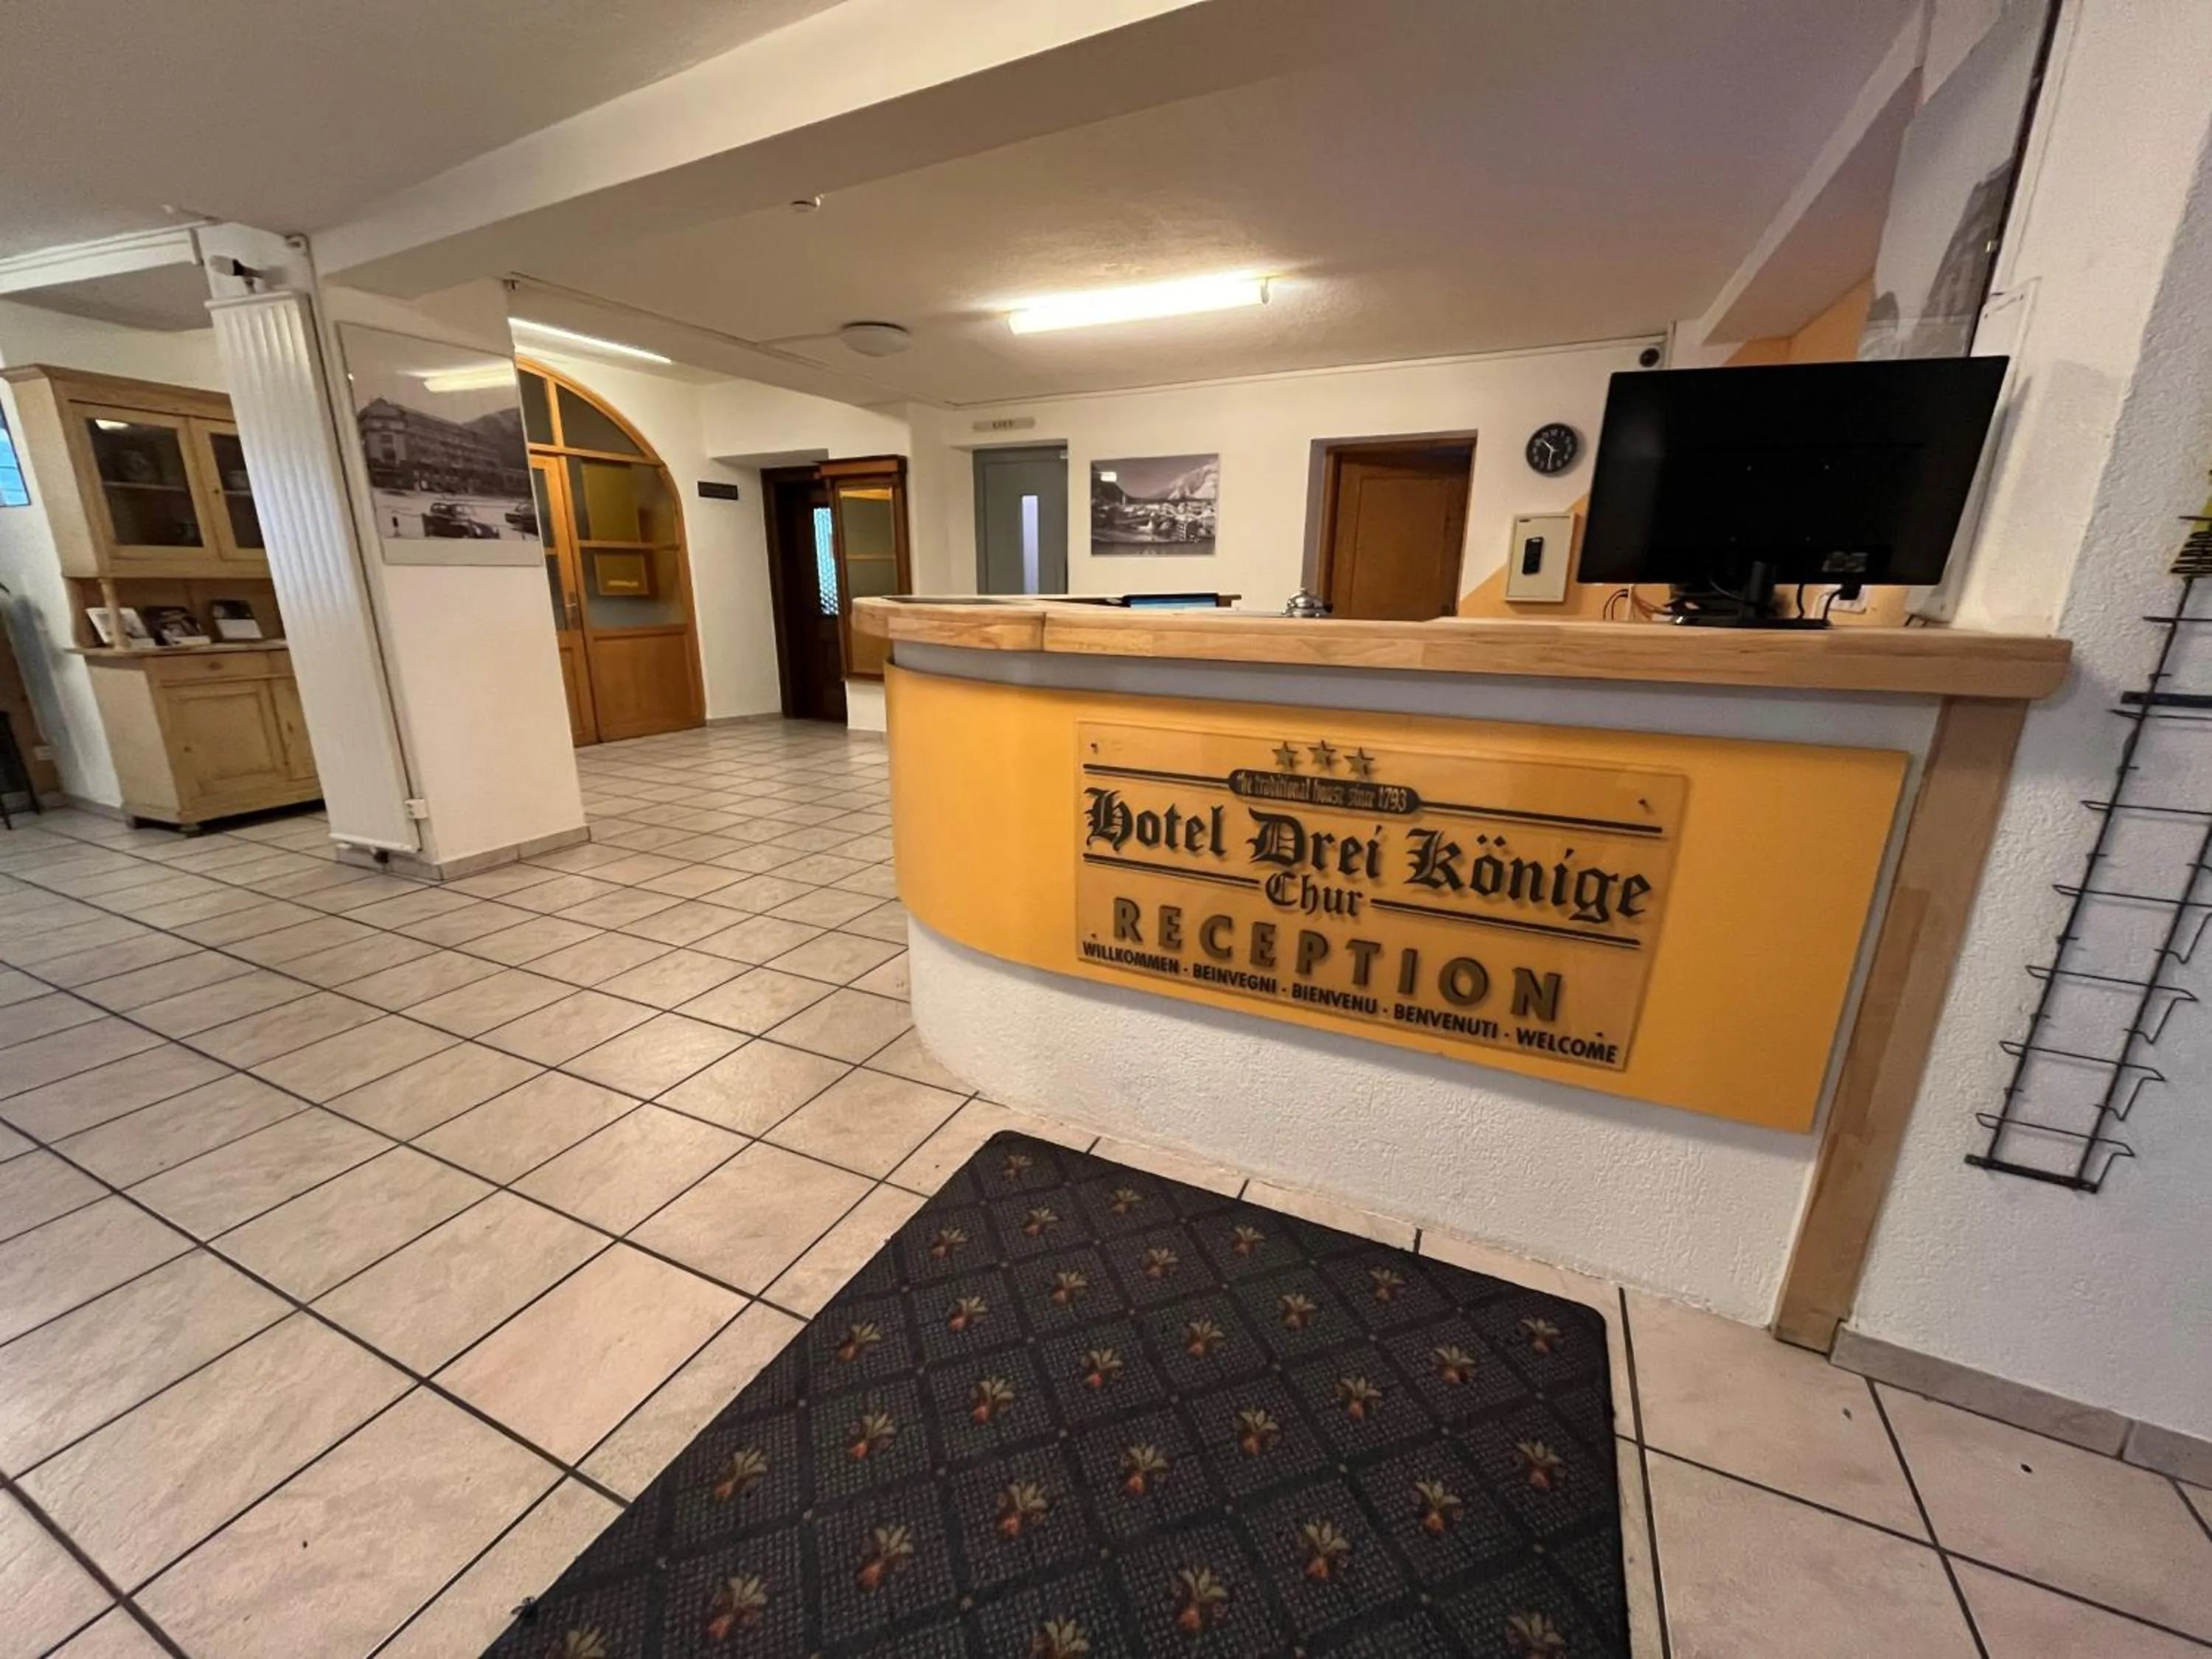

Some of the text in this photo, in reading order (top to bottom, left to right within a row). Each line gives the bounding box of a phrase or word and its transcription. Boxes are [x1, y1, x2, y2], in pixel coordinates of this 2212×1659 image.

[1083, 786, 1652, 924] Hotel Drei Könige
[1255, 773, 1310, 801] traditional
[1312, 778, 1345, 806] house
[1348, 783, 1377, 808] since
[1378, 786, 1408, 813] 1793
[1264, 871, 1364, 917] Chur
[1082, 941, 1618, 1065] WILLKOMMEN BEINVEGNI BIENVENU BENVENUTI WELCOME
[1113, 896, 1563, 1023] RECEPTION
